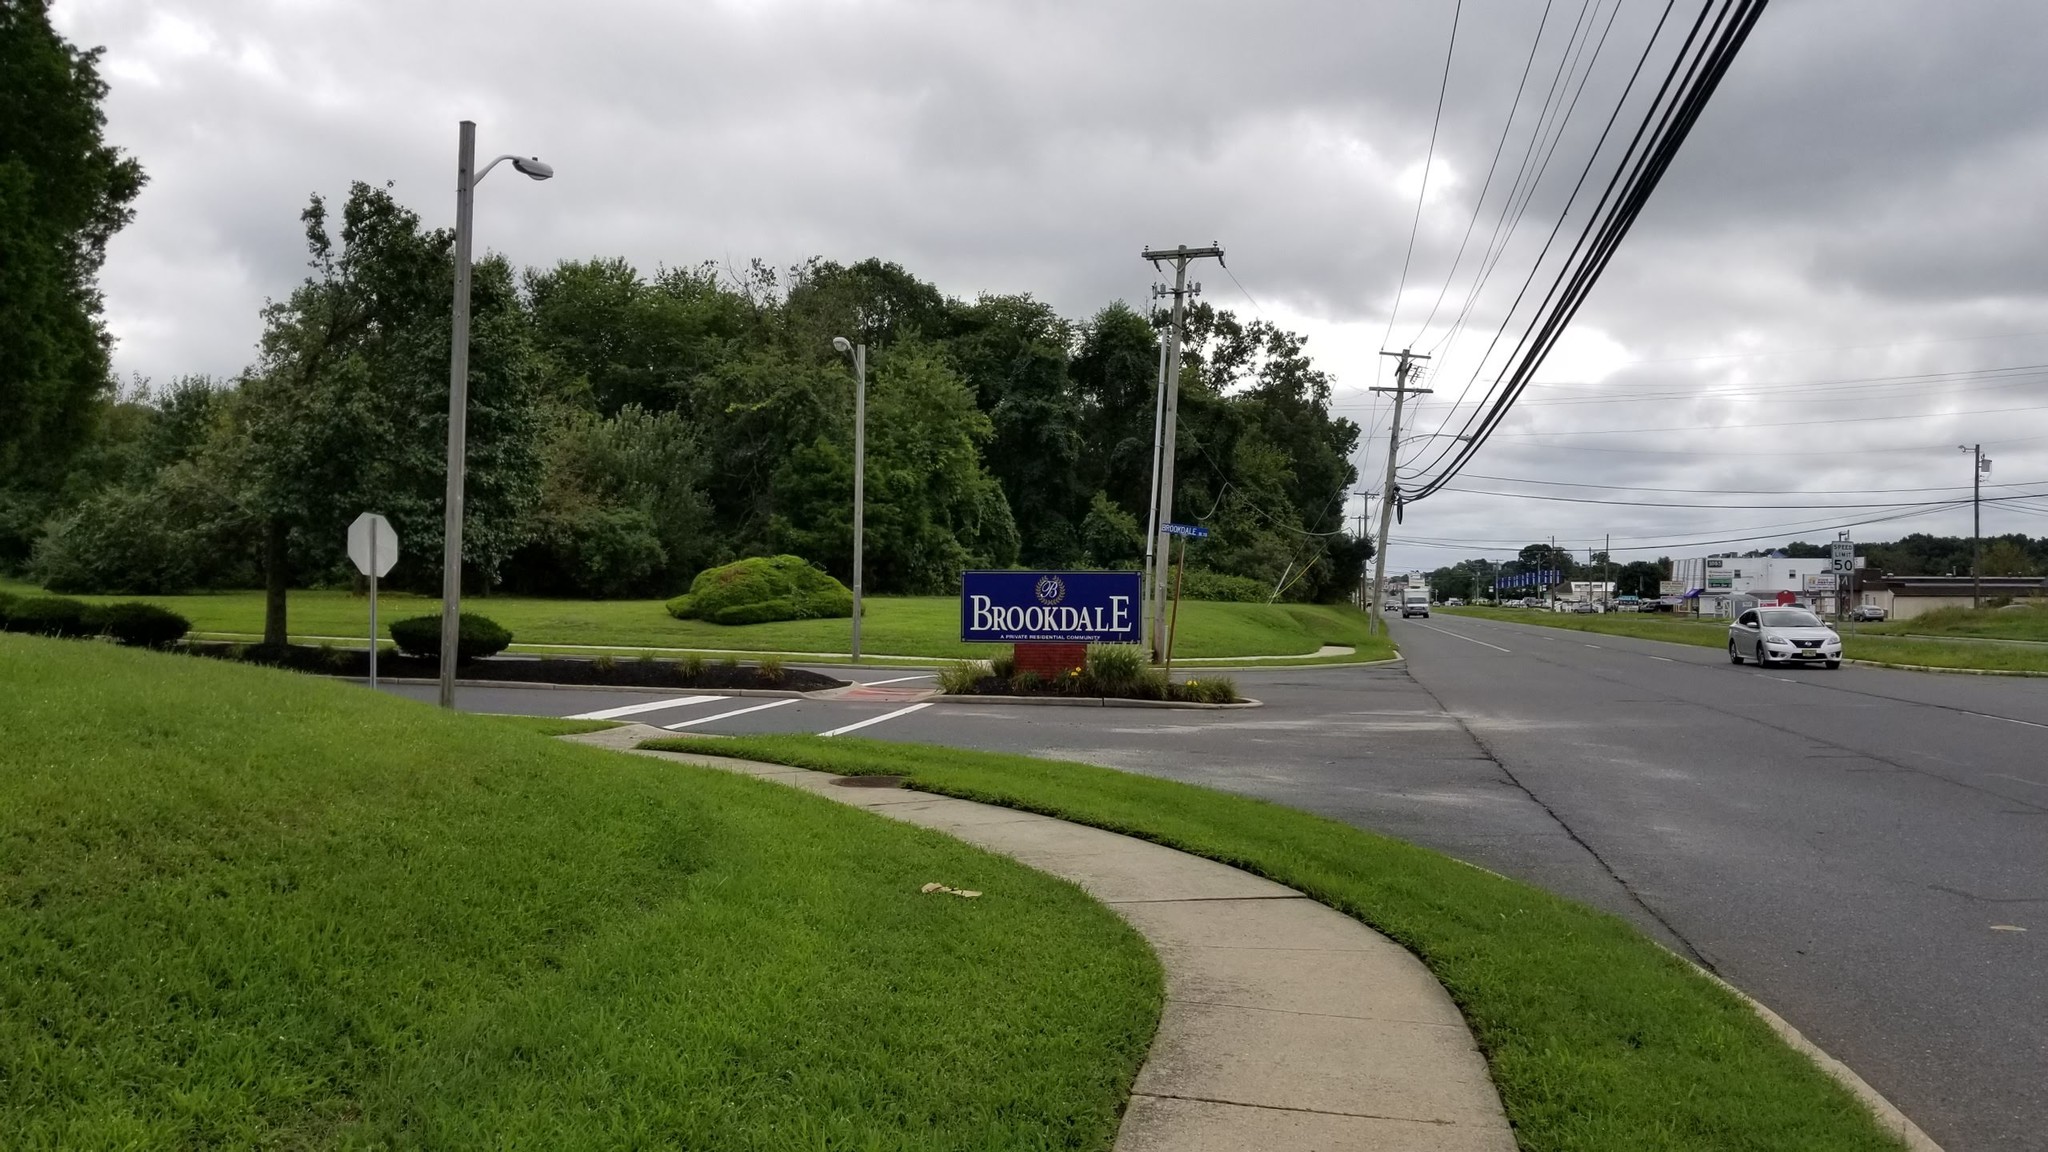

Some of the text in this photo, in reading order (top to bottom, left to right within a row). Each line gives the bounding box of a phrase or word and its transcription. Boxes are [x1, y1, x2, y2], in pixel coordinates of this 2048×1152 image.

[1161, 524, 1197, 536] BROOKDALE
[1834, 559, 1853, 571] 50
[970, 595, 1132, 632] BROOKDALE
